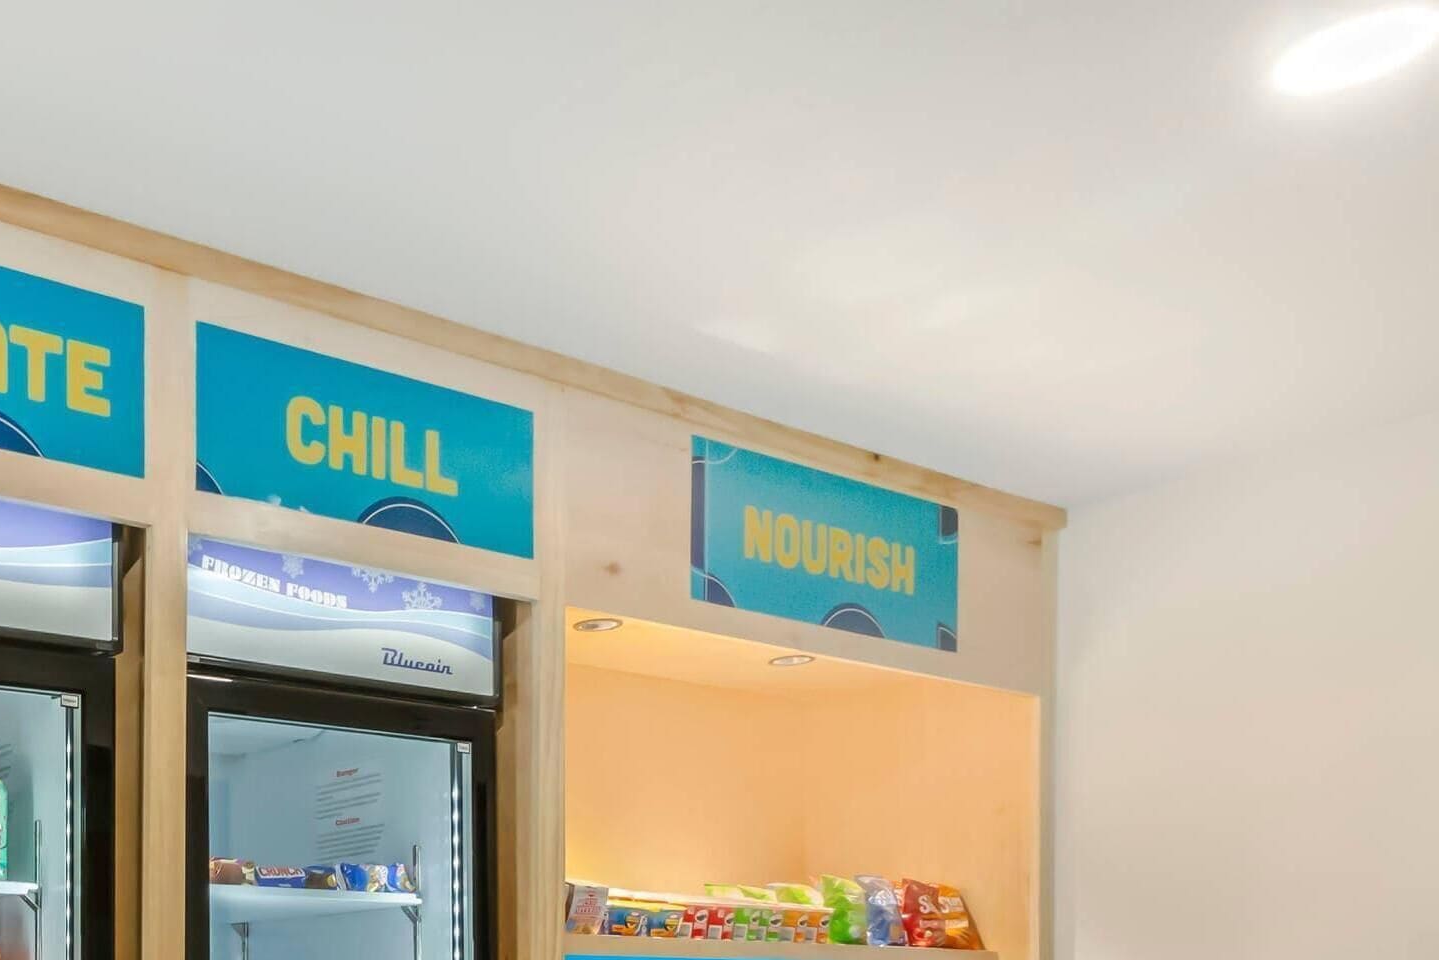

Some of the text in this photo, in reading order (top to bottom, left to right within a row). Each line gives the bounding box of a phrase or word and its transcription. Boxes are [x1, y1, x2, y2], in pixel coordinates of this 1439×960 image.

[285, 394, 460, 497] CHILL
[201, 555, 349, 610] FROZEN FOODS
[743, 504, 916, 596] NOURISH
